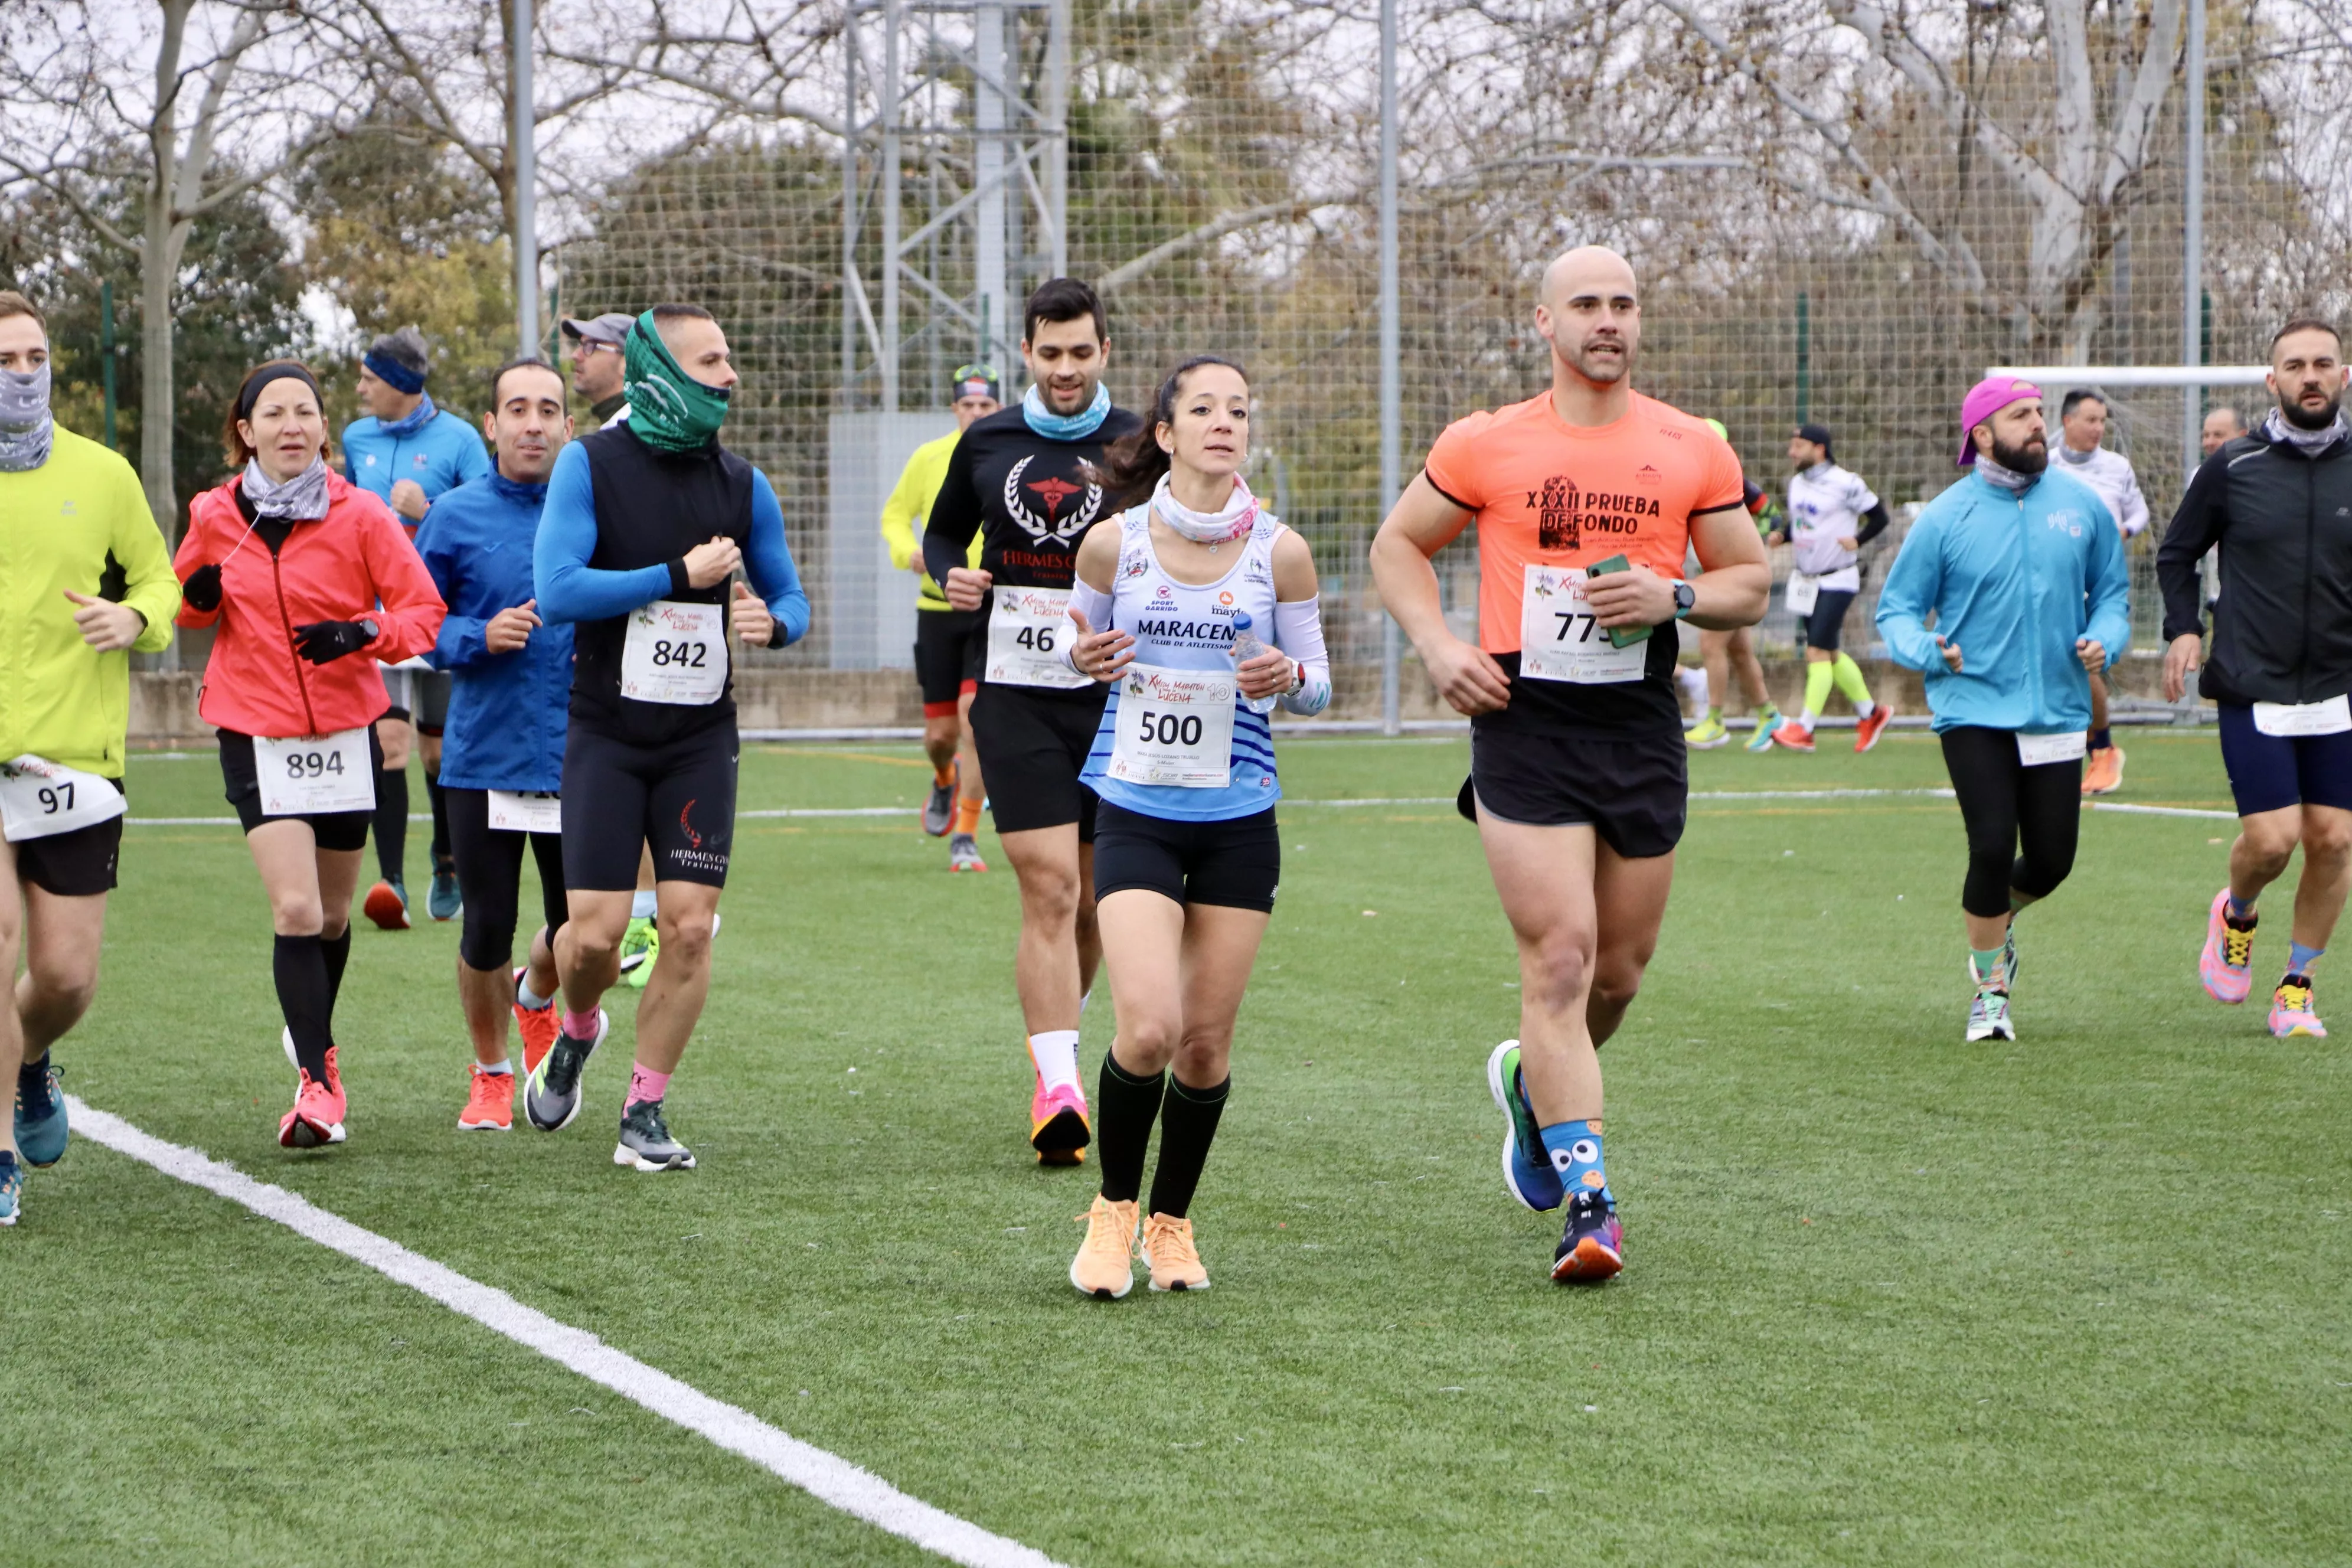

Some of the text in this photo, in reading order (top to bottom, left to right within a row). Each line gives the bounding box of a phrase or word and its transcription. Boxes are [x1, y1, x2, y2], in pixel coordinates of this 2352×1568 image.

[1526, 491, 1660, 518] XXXII PRUEBA
[1544, 513, 1638, 534] DE FONDO
[1002, 550, 1063, 569] HERMES
[1033, 571, 1069, 580] Training
[1138, 619, 1237, 641] MARACEN
[652, 640, 707, 668] 842
[1151, 638, 1171, 646] CLUB
[1186, 642, 1233, 651] ATLETISMO
[1157, 688, 1196, 704] LUCENA
[1139, 711, 1203, 746] 500
[286, 750, 345, 779] 894
[38, 781, 75, 814] 97
[670, 849, 714, 863] HERMES
[681, 858, 723, 873] Training
